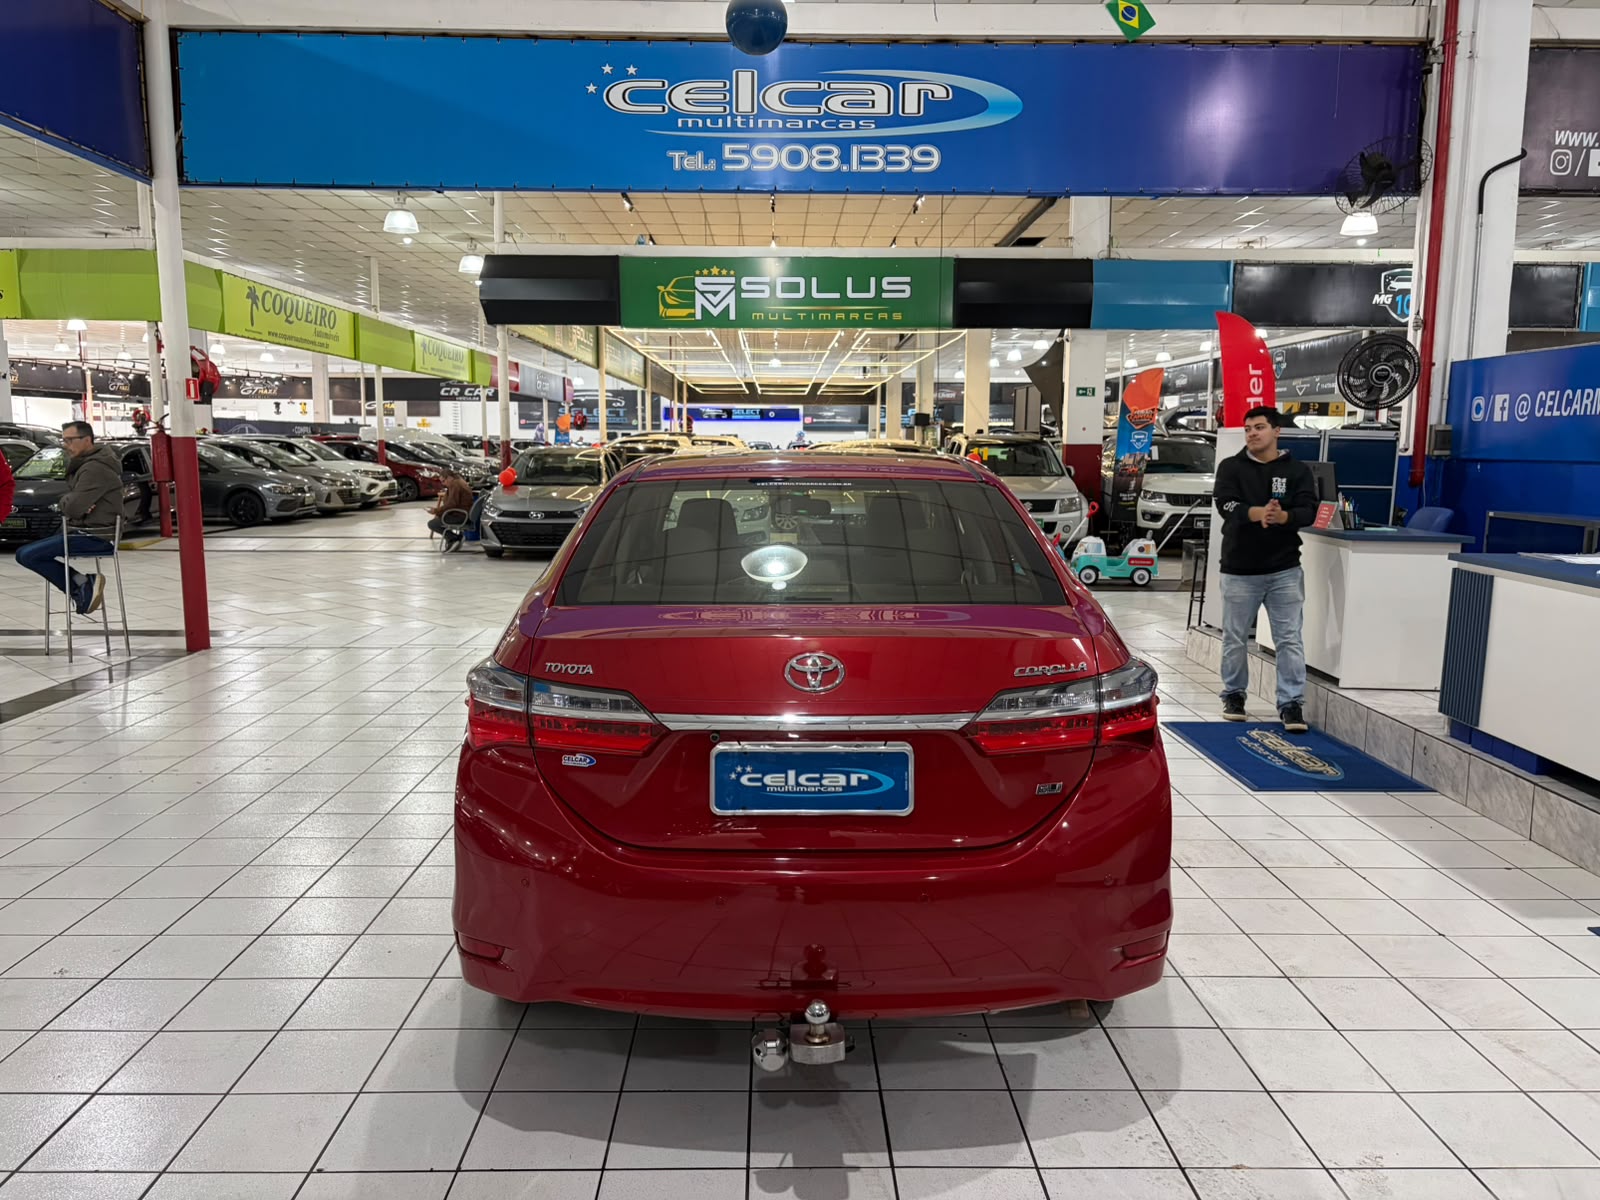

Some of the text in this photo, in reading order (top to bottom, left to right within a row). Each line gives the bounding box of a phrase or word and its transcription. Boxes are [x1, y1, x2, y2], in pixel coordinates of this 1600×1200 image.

[603, 69, 953, 116] celcar
[677, 116, 876, 129] multimarcas
[721, 143, 942, 172] 5908.1339
[740, 276, 912, 299] SOLUS
[1372, 294, 1393, 305] MG
[261, 290, 337, 330] COQUEIRO
[751, 312, 903, 321] MULTIMARCAS
[427, 339, 465, 363] COQUEIRO
[440, 387, 461, 396] CR
[545, 662, 594, 674] TOYOTA
[1014, 661, 1088, 677] COROLLA
[740, 769, 869, 787] celcar
[766, 785, 843, 793] multimarcas
